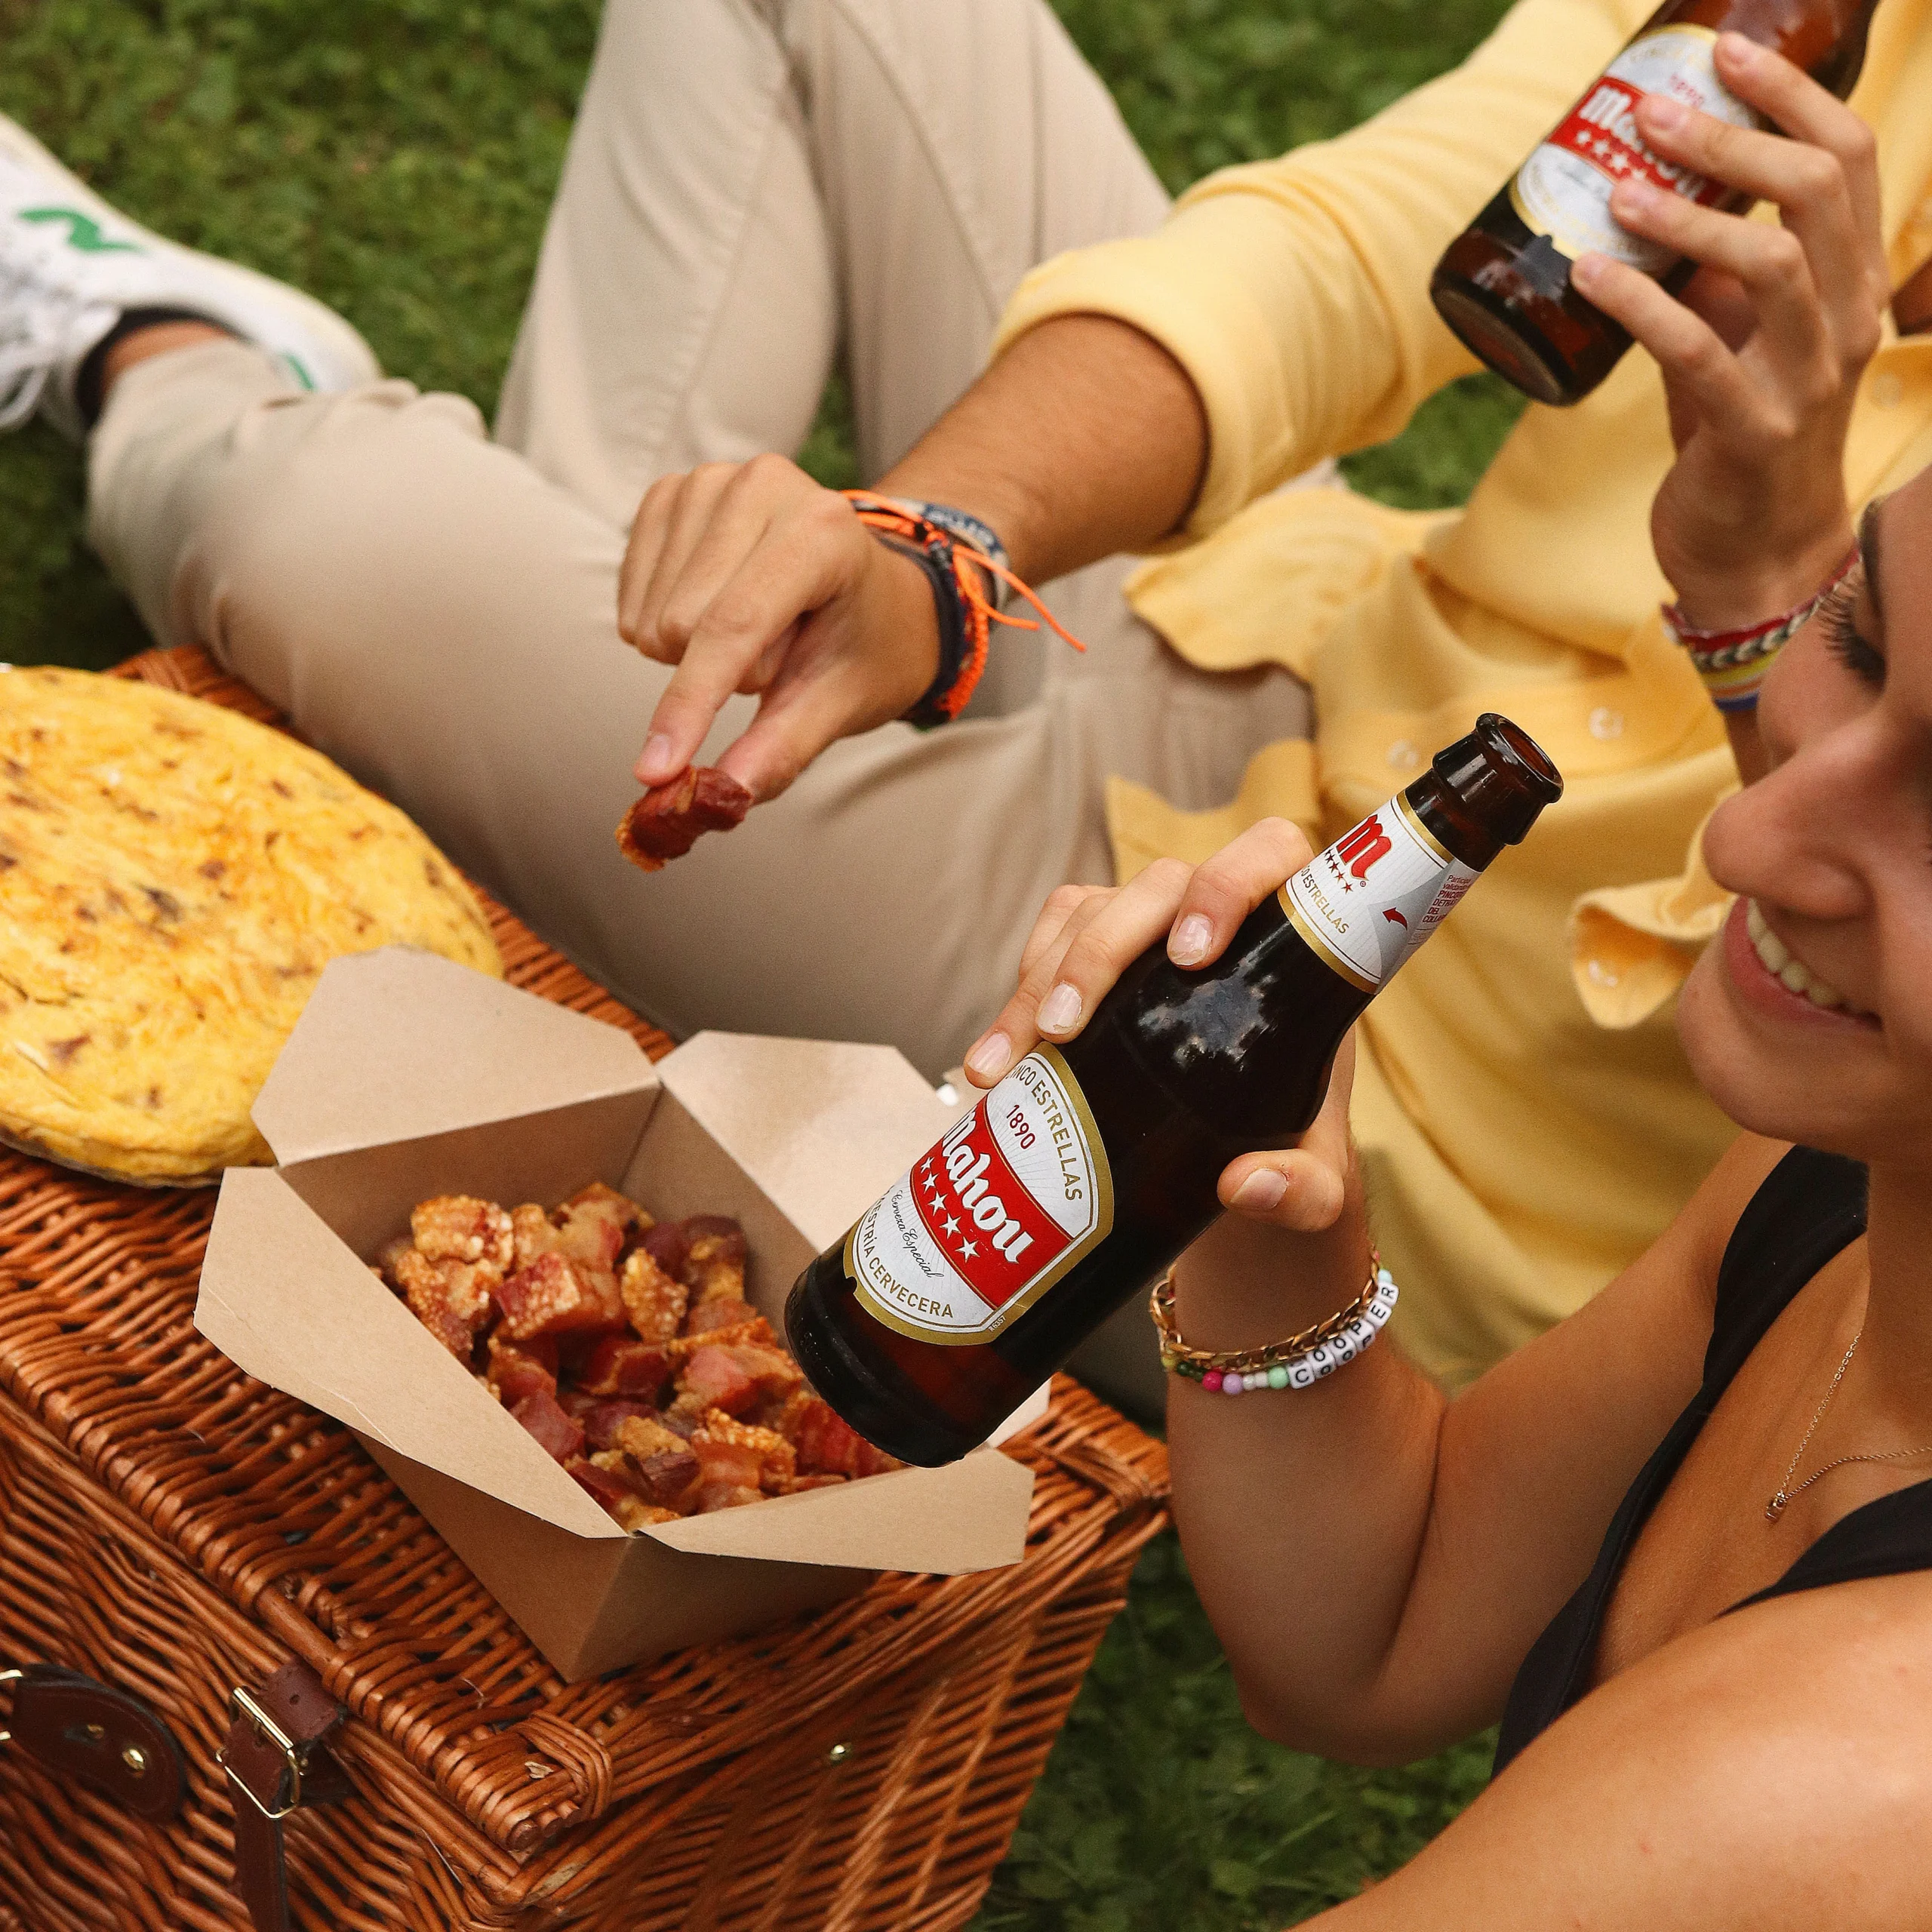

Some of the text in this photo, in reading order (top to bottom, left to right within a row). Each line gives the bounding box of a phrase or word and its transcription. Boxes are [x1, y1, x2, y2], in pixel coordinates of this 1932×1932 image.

[1303, 873, 1349, 934] ESTRELLAS
[1005, 1065, 1082, 1201] INCO ESTRELLAS
[1006, 1104, 1035, 1150] 1890
[891, 1190, 944, 1278] Cerveza Especial
[869, 1257, 954, 1318] CERVECERA
[1295, 1286, 1395, 1383] COOPER
